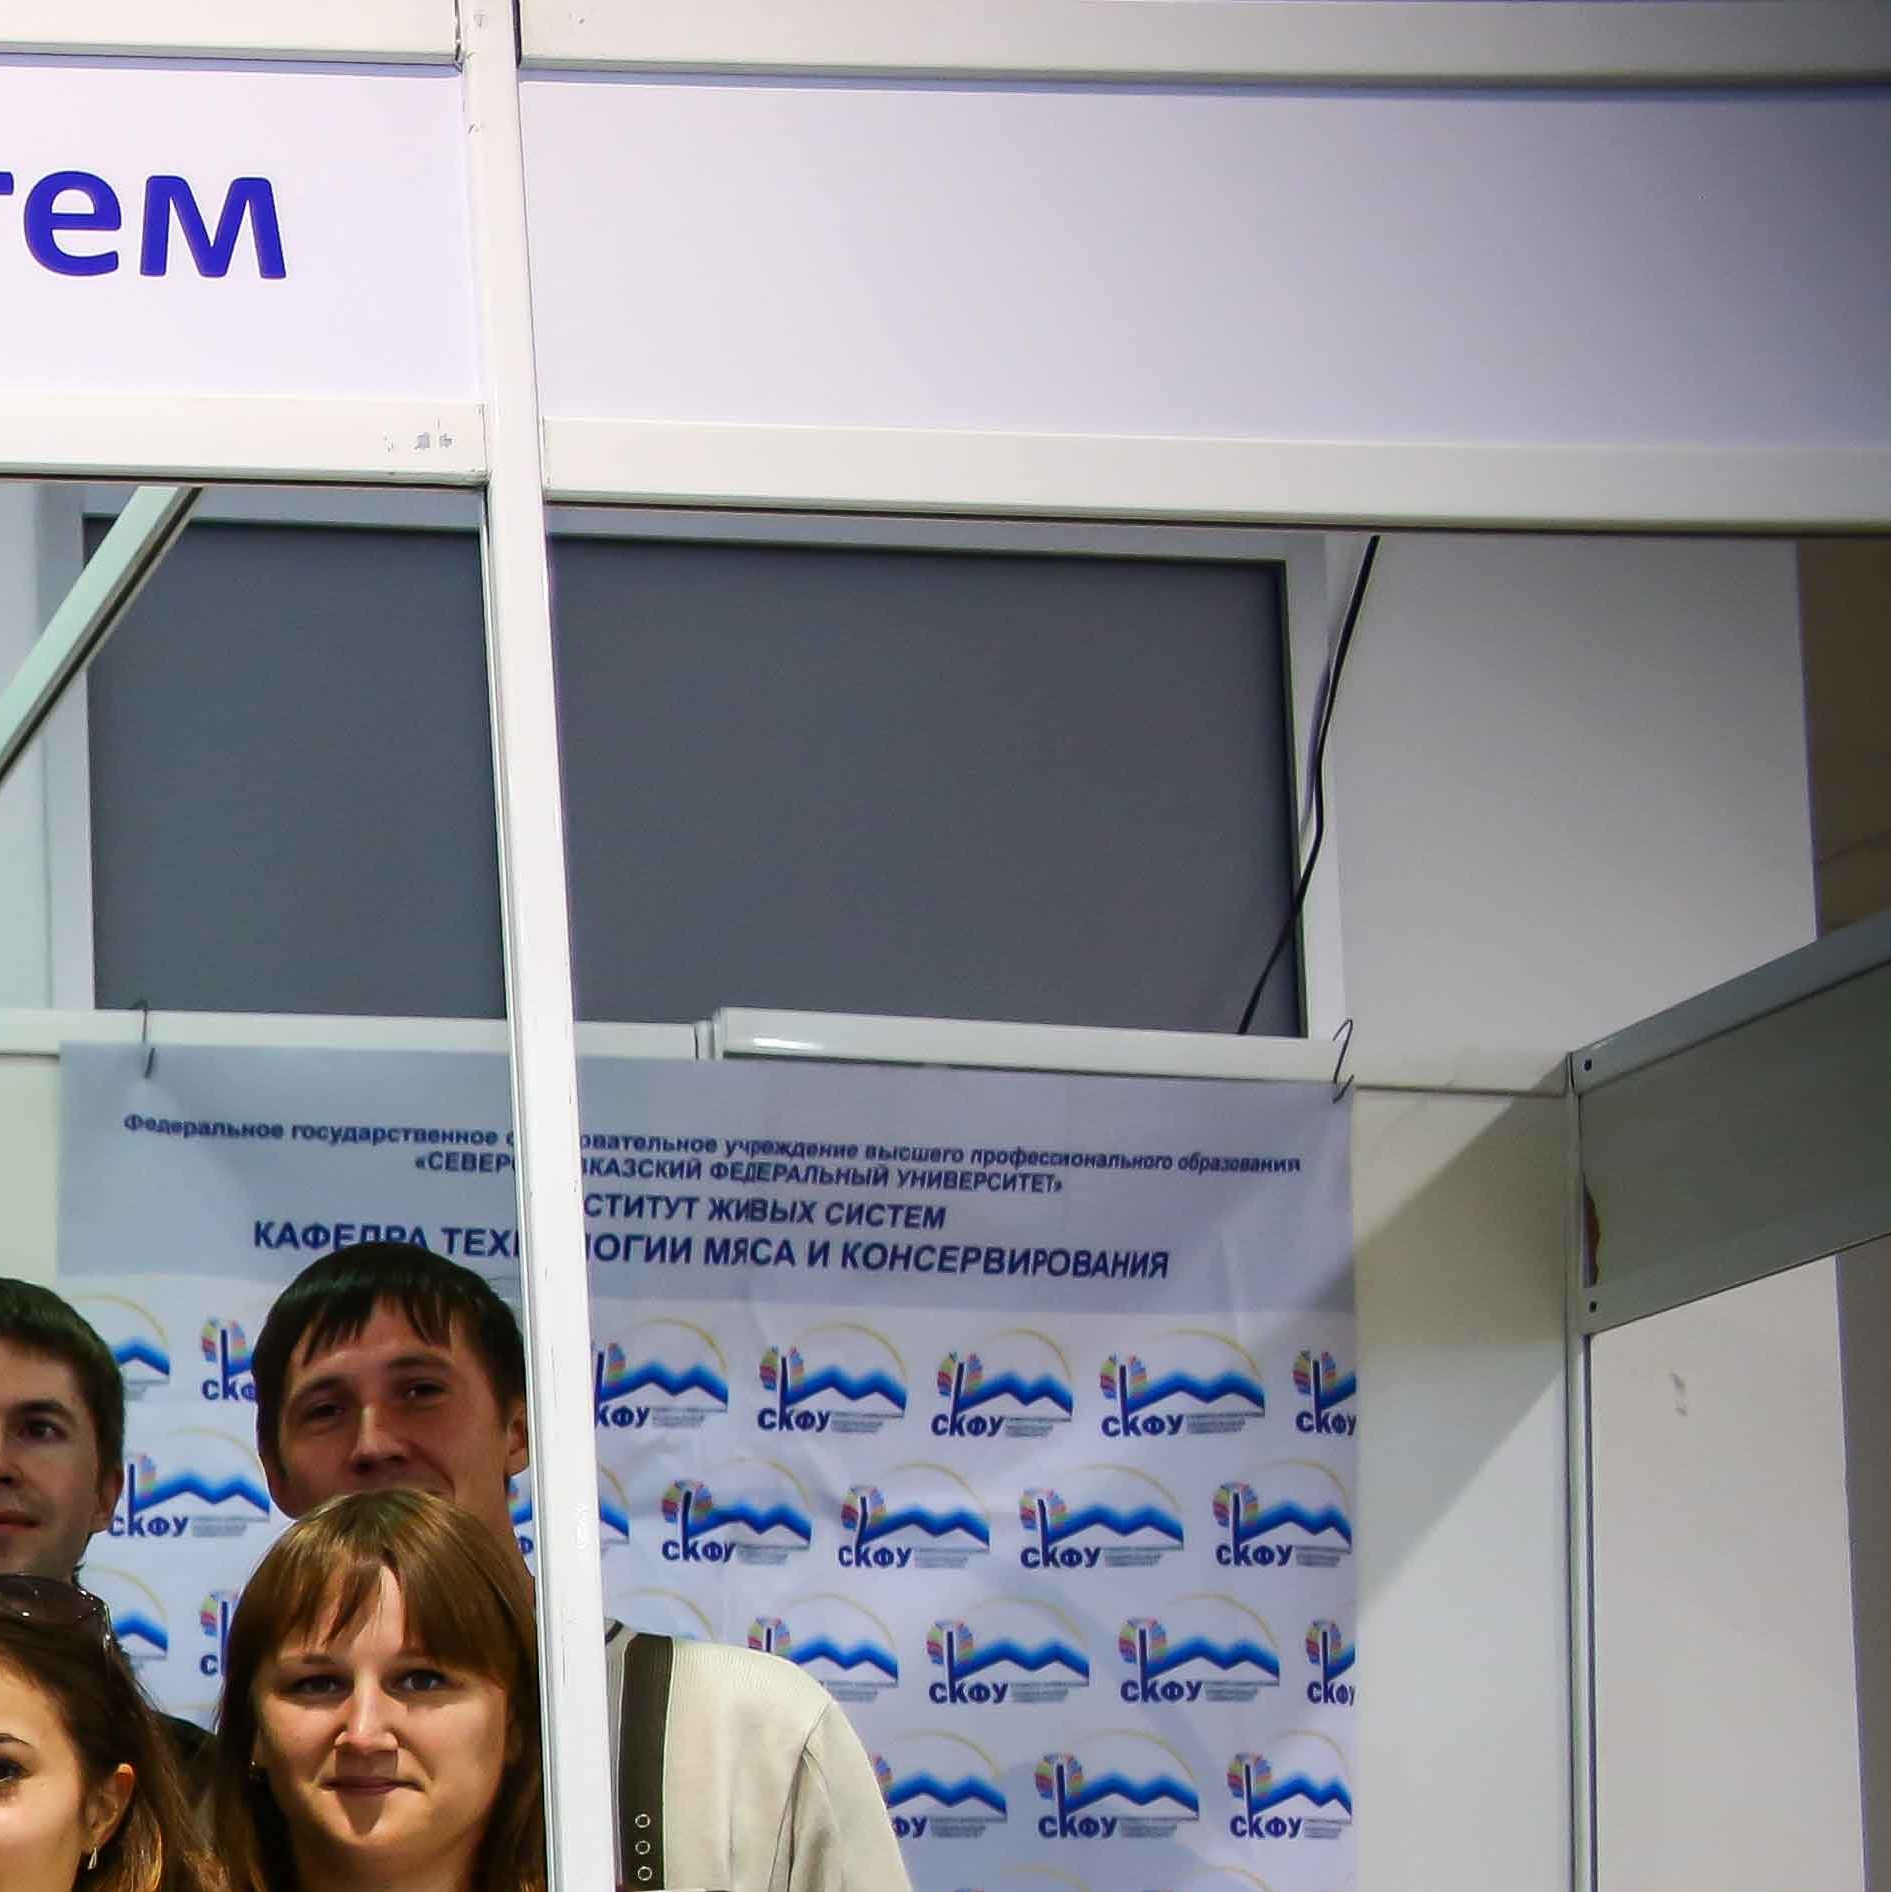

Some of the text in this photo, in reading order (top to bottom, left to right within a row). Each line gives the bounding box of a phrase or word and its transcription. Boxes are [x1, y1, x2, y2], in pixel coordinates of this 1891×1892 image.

[123, 1114, 283, 1141] Федеральное
[292, 1122, 498, 1147] государственное
[726, 1137, 858, 1160] учреждение
[865, 1144, 964, 1167] высшего
[971, 1145, 1172, 1171] профессионального
[1178, 1153, 1300, 1174] образования
[710, 1160, 889, 1188] ФЕДЕРАЛЬНЫЙ
[897, 1167, 1064, 1194] УНИВЕРСИТЕТ»
[584, 1193, 946, 1232] СТИТУТ ЖИВЫХ СИСТЕМ
[703, 1236, 796, 1268] МЯСА
[807, 1239, 833, 1268] И
[841, 1240, 1171, 1279] КОНСЕРВИРОВАНИЯ
[593, 1403, 651, 1432] КФУ
[757, 1401, 830, 1434] СКФУ
[930, 1411, 1004, 1438] СКФУ
[1101, 1410, 1184, 1438] СКФУ
[108, 1514, 188, 1538] СКФУ
[661, 1537, 736, 1564] СКФУ
[838, 1541, 912, 1570] СКФУ
[1020, 1543, 1101, 1570] СКФУ
[1216, 1541, 1293, 1568] СКФУ
[928, 1678, 1009, 1706] СКФУ
[1120, 1675, 1201, 1704] СКФУ
[1037, 1812, 1118, 1840] СКФУ
[1230, 1811, 1303, 1840] СКФУ
